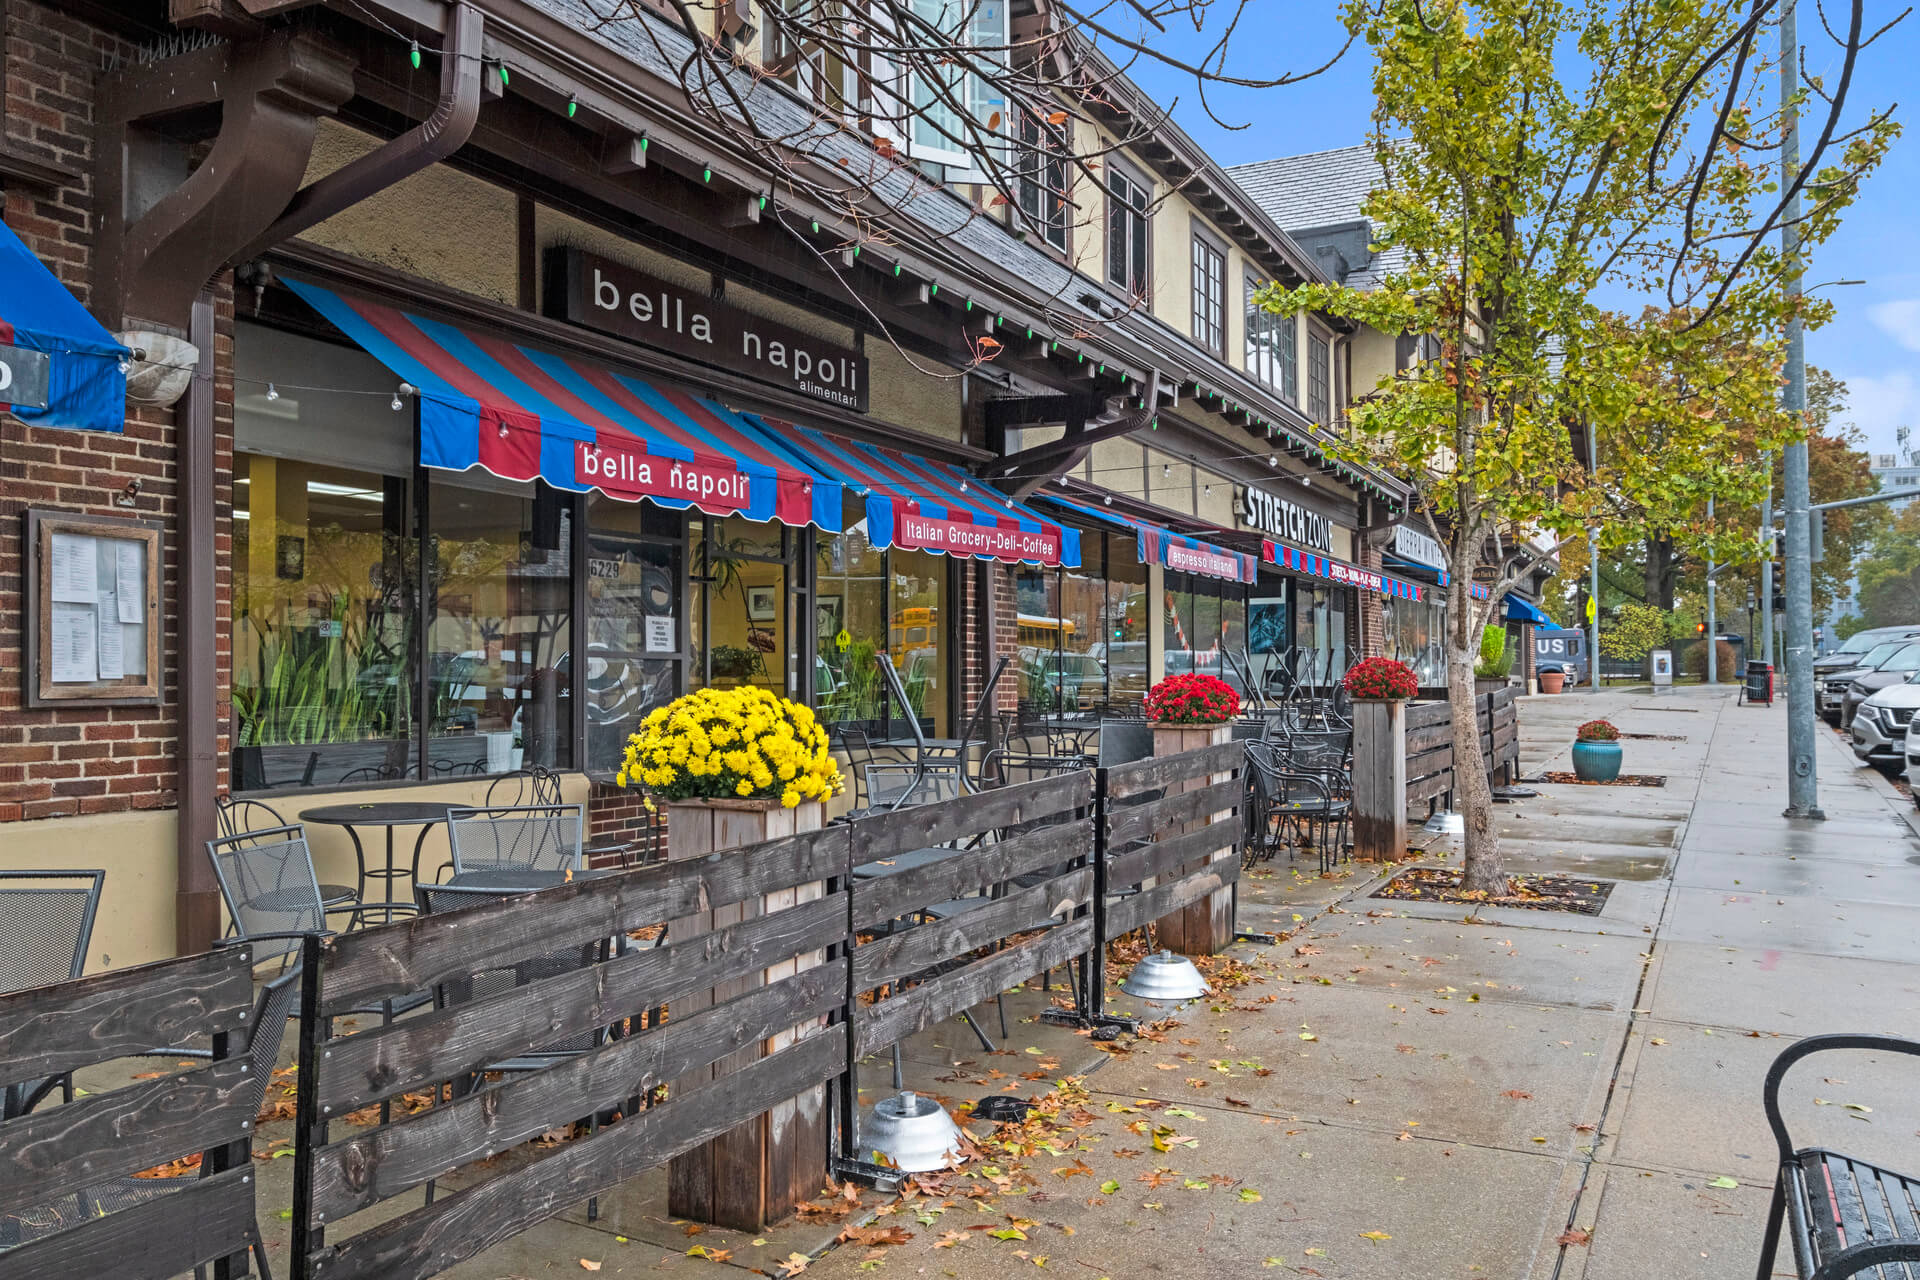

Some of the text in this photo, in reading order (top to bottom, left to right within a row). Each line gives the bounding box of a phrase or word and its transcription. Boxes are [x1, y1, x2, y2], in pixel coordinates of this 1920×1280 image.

[594, 268, 856, 391] bella napoli
[799, 379, 857, 407] alimentari
[583, 446, 745, 500] bella napoli
[1247, 485, 1334, 553] STRETCH ZONE
[905, 519, 1054, 556] Italian Grocery-Deli-Coffee
[1399, 526, 1422, 560] SIERRA
[590, 560, 620, 578] 6229
[1172, 551, 1207, 568] espresso
[1537, 638, 1564, 654] US
